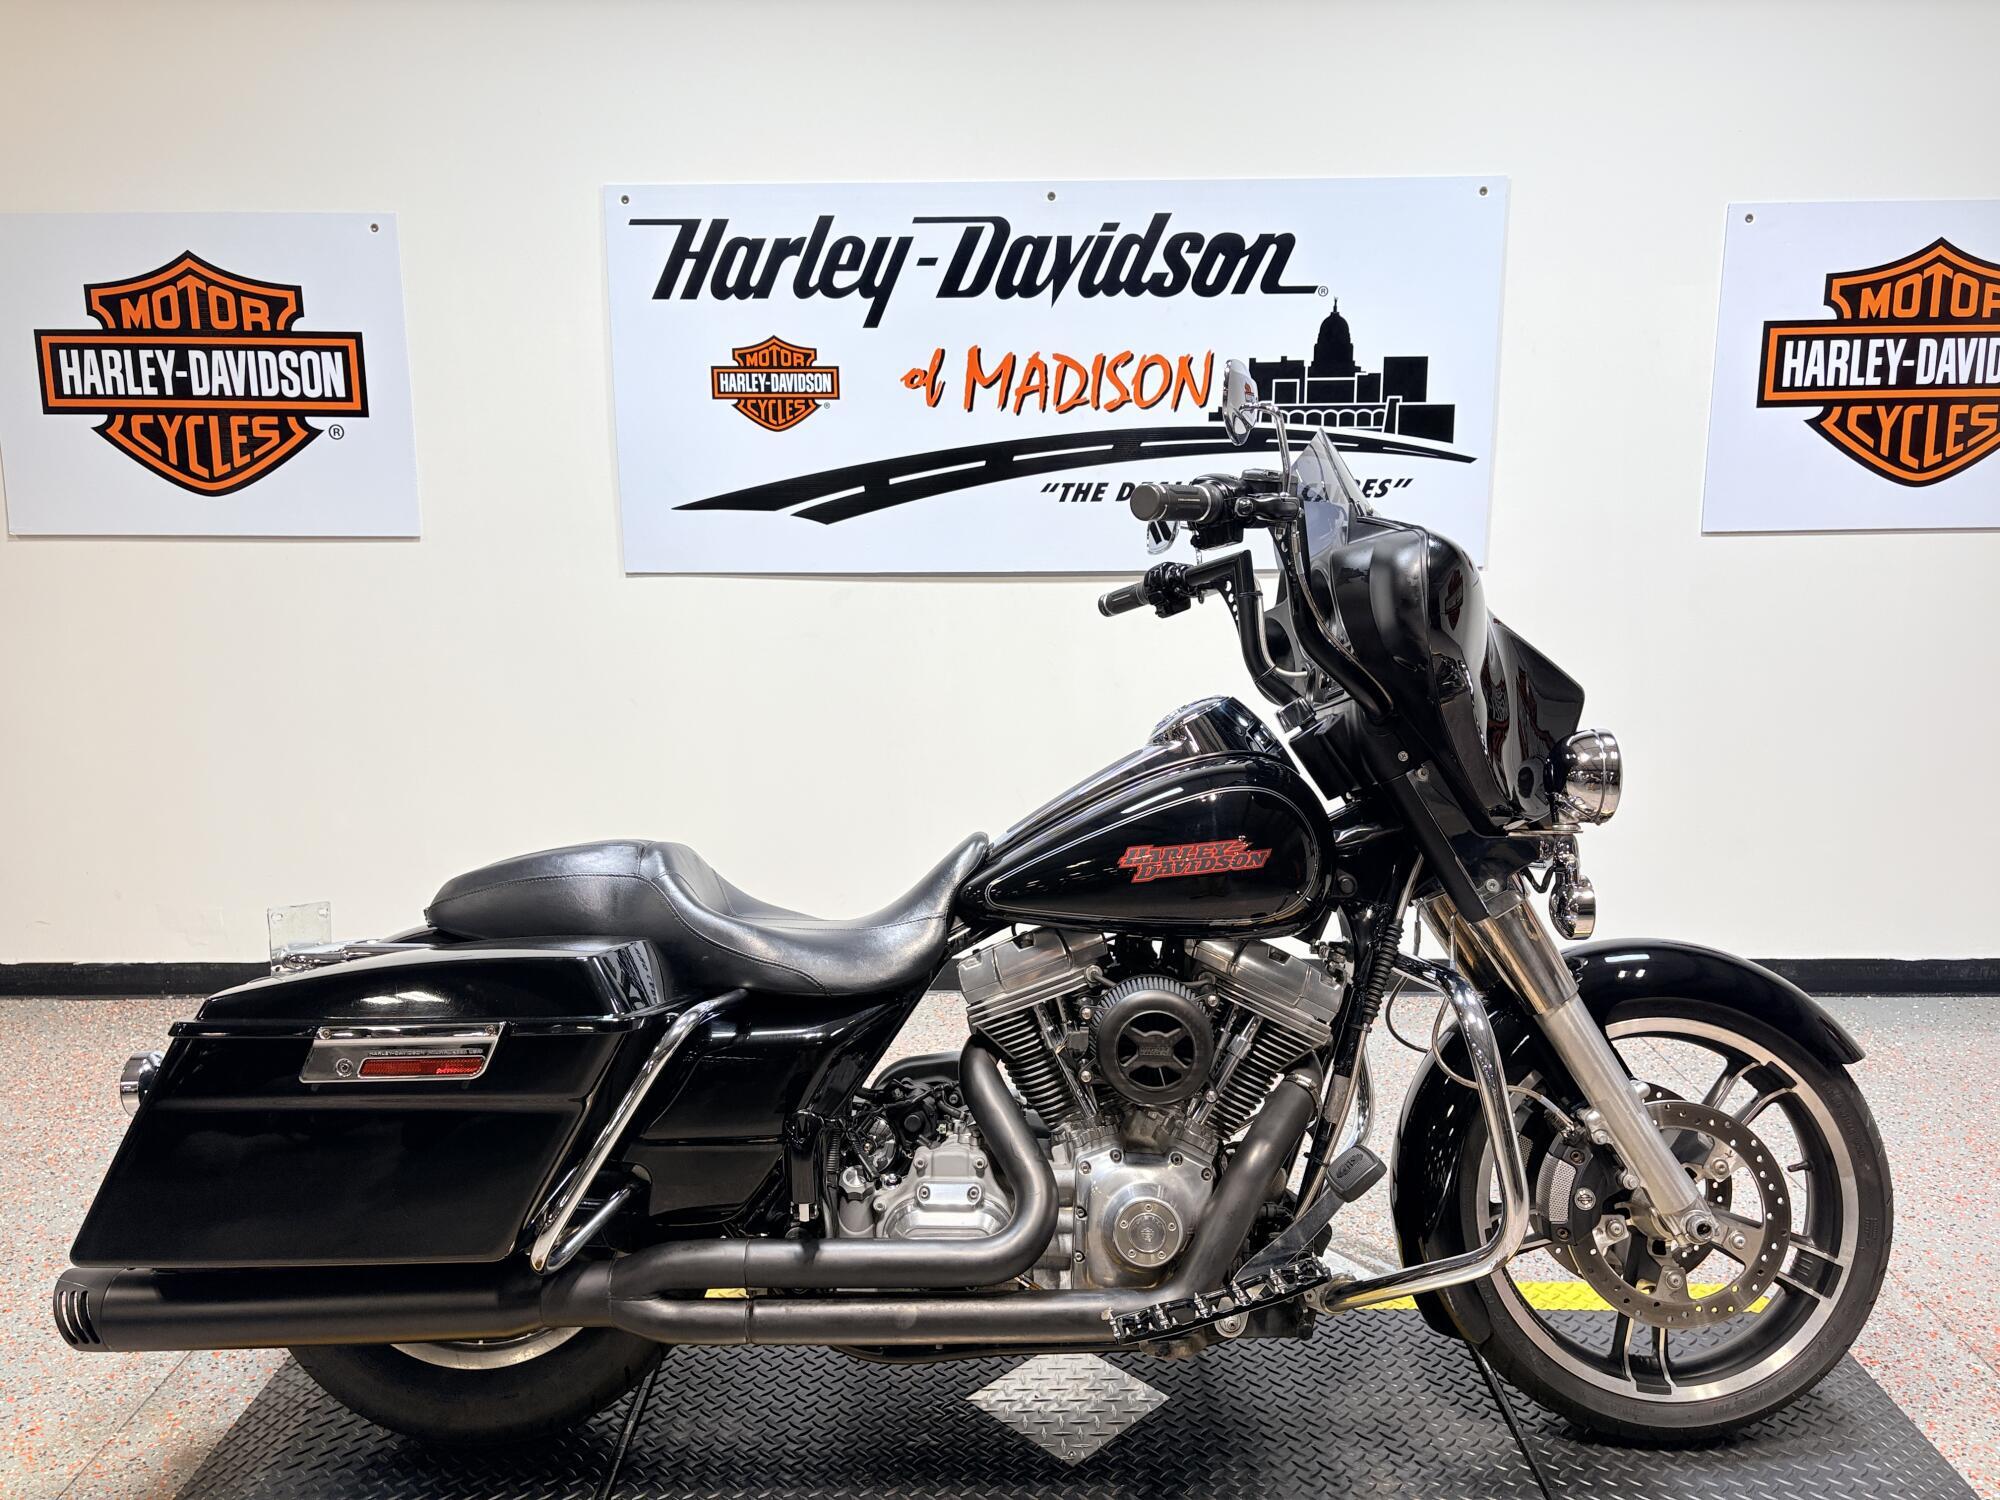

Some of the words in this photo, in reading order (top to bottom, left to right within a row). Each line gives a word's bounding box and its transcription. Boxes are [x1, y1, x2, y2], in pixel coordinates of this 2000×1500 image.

[629, 213, 1318, 328] Harley-Davidson
[121, 274, 270, 331] MOTOR
[59, 349, 346, 398] HARLEY-DAVIDSON
[745, 344, 804, 367] MOTOR
[720, 373, 832, 393] HARLEY-DAVIDSON
[900, 347, 945, 408] of
[964, 345, 1214, 416] MADISON
[747, 399, 806, 425] CYCLES
[1847, 404, 2000, 469] CYCLES
[131, 414, 280, 479] CYCLES
[1119, 840, 1243, 867] HARLEY
[1132, 850, 1272, 882] DAVIDSON
